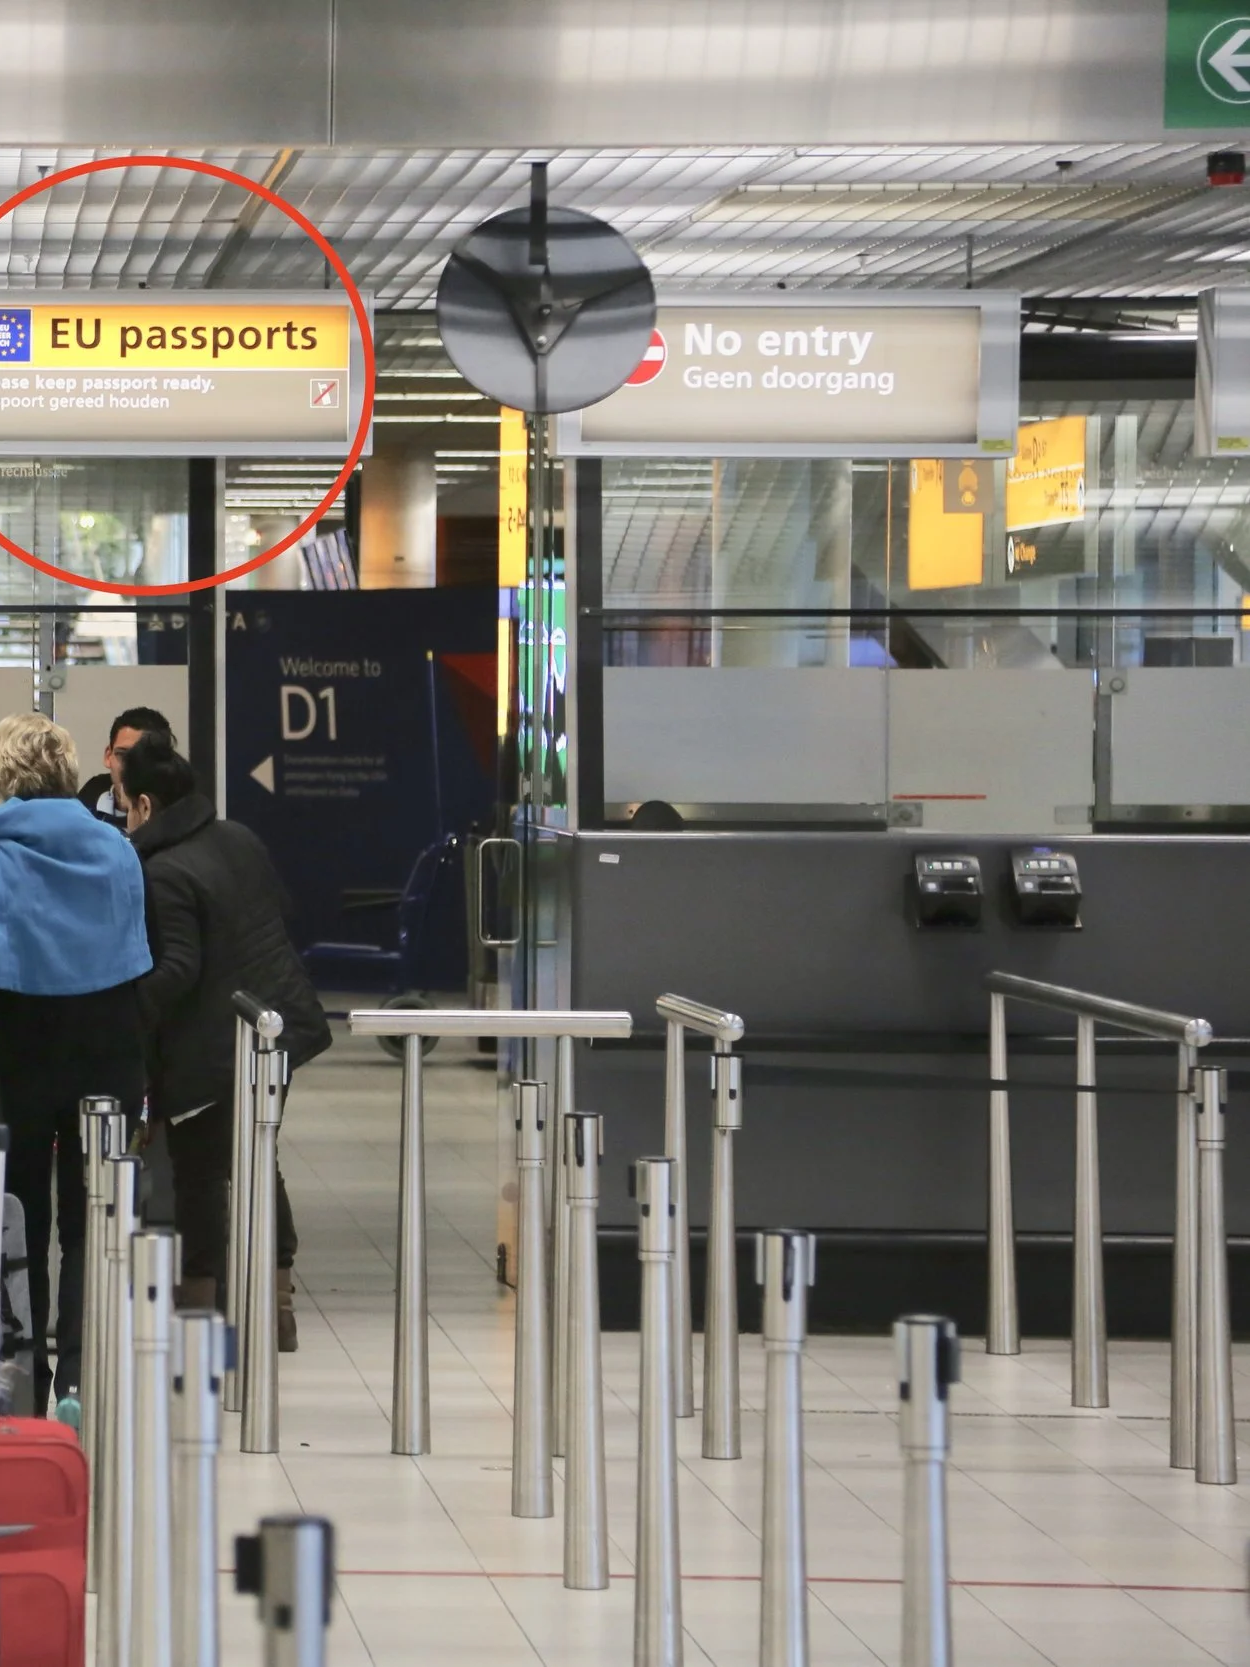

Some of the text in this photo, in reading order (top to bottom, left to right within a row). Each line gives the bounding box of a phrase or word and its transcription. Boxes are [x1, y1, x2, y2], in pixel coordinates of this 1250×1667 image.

[51, 318, 318, 358] EU passports
[684, 323, 874, 366] No entry
[35, 374, 77, 393] keep
[82, 376, 158, 393] passport
[163, 375, 215, 394] ready.
[683, 365, 895, 396] Geen doorgang
[50, 394, 104, 411] gereed
[109, 394, 170, 409] houden
[279, 657, 382, 677] Welcome to
[280, 684, 338, 741] D1
